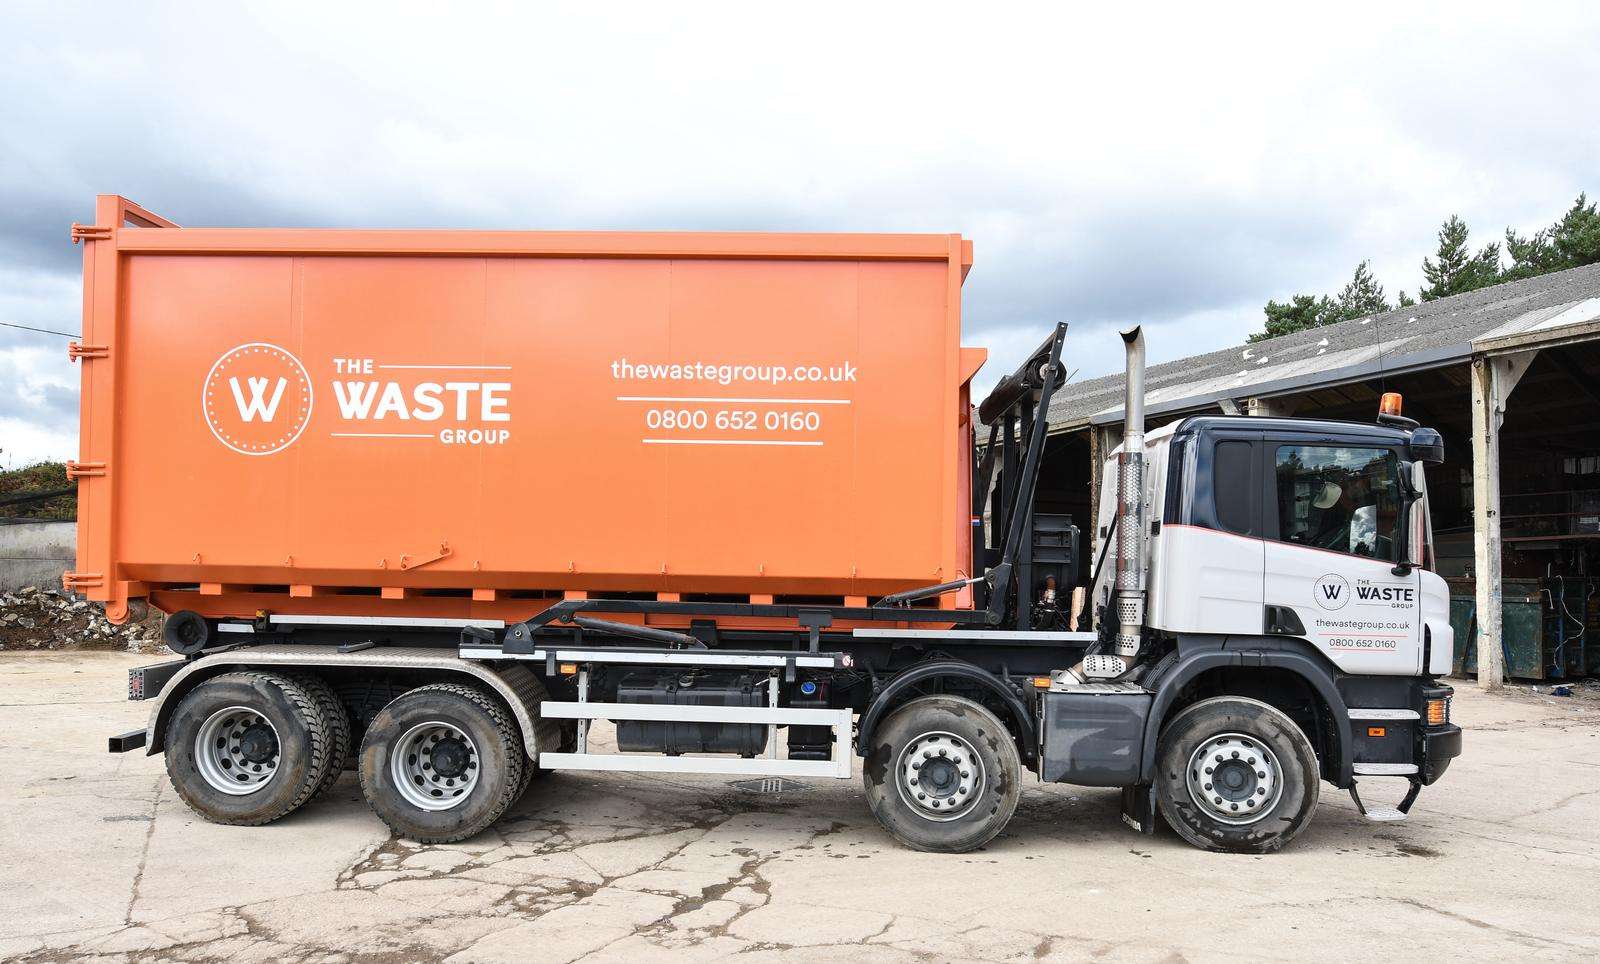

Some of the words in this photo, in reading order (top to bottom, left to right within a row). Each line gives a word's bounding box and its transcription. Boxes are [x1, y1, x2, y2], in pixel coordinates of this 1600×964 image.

[333, 358, 373, 374] THE
[611, 358, 857, 385] thewastegroup.co.uk
[332, 380, 511, 421] WASTE
[646, 409, 708, 429] 0800
[715, 410, 757, 430] 652
[764, 411, 820, 430] 0160
[439, 428, 510, 444] GROUP
[1356, 586, 1414, 601] WASTE
[1316, 619, 1410, 630] thewastegroup.co.uk
[1329, 638, 1353, 648] 0800
[1356, 639, 1372, 648] 652
[1375, 639, 1396, 648] 0160
